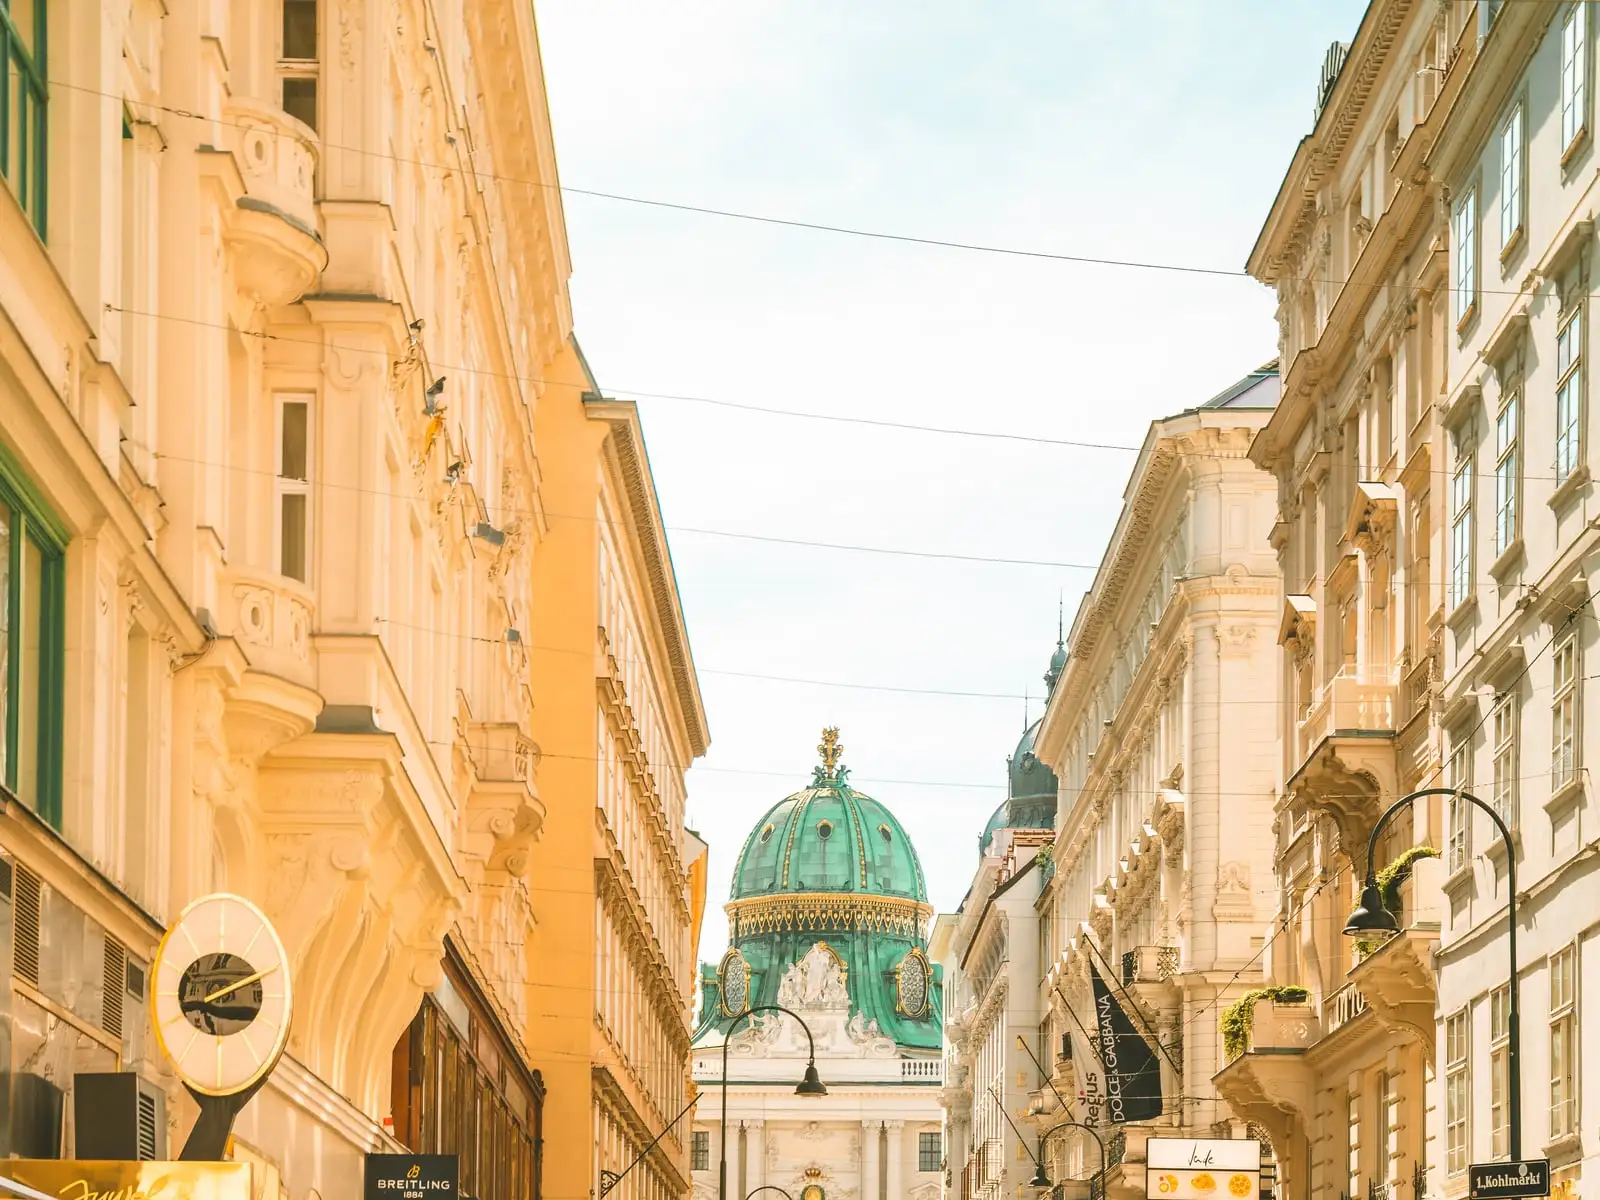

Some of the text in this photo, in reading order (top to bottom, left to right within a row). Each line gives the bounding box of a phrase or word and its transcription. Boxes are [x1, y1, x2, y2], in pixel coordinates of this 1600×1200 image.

[1098, 994, 1117, 1068] GABBANA
[1108, 1075, 1125, 1122] DOLCE
[377, 1179, 450, 1190] BREITLING
[1485, 1171, 1541, 1187] Kohlmarkt
[403, 1191, 424, 1199] 1884
